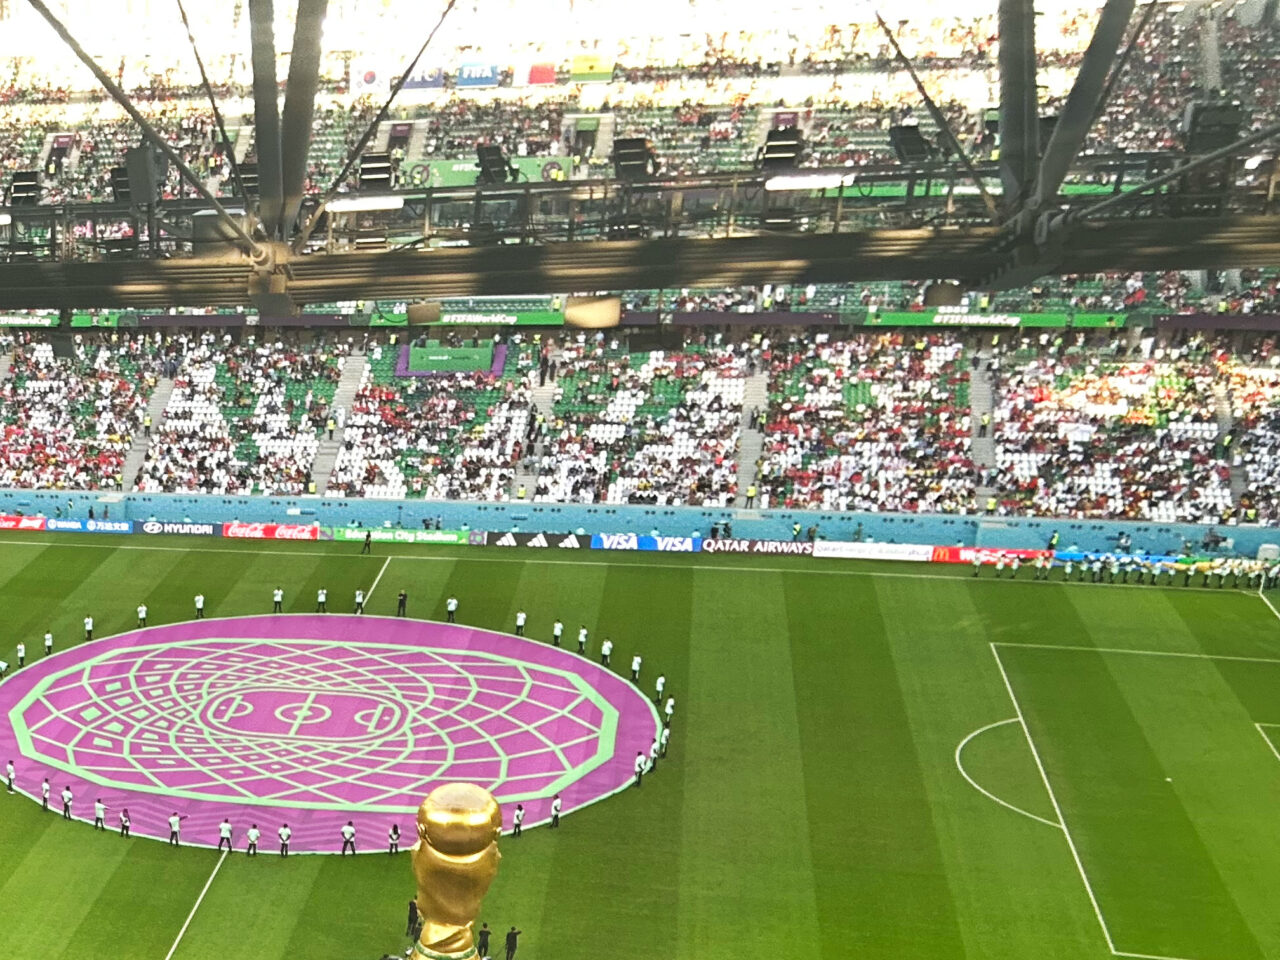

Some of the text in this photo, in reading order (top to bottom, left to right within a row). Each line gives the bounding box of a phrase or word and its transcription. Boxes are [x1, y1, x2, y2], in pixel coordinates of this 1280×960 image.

[442, 314, 517, 324] #FIFAWorldCup
[933, 314, 1020, 327] #FIFAWorldCup
[164, 524, 213, 535] HYUNDAI
[394, 531, 415, 542] City
[416, 531, 458, 542] Stadium
[600, 533, 638, 550] VISA
[656, 537, 693, 551] VISA
[702, 539, 813, 554] QATAR AIRWAYS
